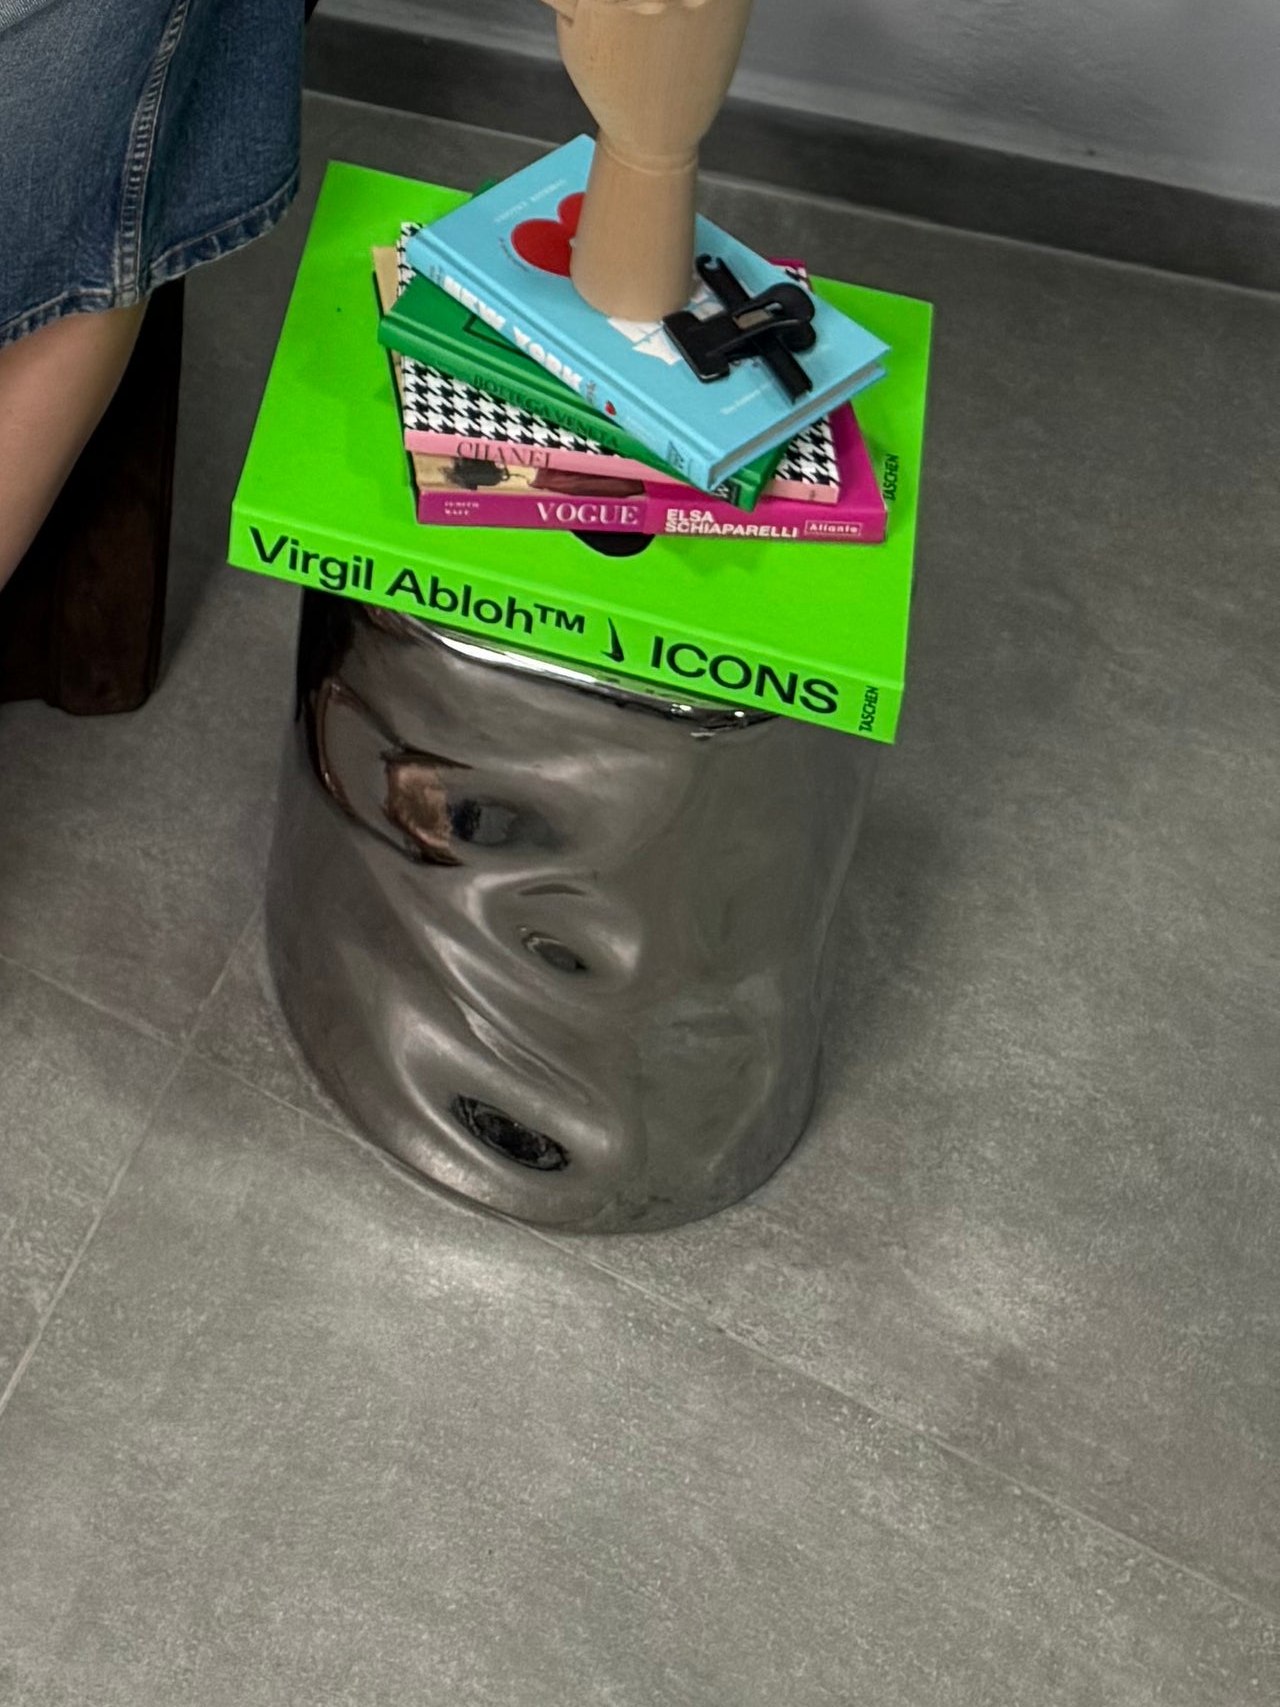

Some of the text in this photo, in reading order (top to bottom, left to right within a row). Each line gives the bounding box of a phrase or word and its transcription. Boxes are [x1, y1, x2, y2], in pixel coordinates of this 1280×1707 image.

[441, 274, 585, 392] NEW YORK
[456, 441, 551, 469] CHANEL
[535, 502, 639, 526] VOGUE
[667, 509, 715, 524] ELSA
[665, 521, 799, 539] SCHIAPARELLI
[249, 526, 374, 593] Virgil
[651, 635, 838, 715] ICONS
[858, 685, 879, 732] TASCHEN
